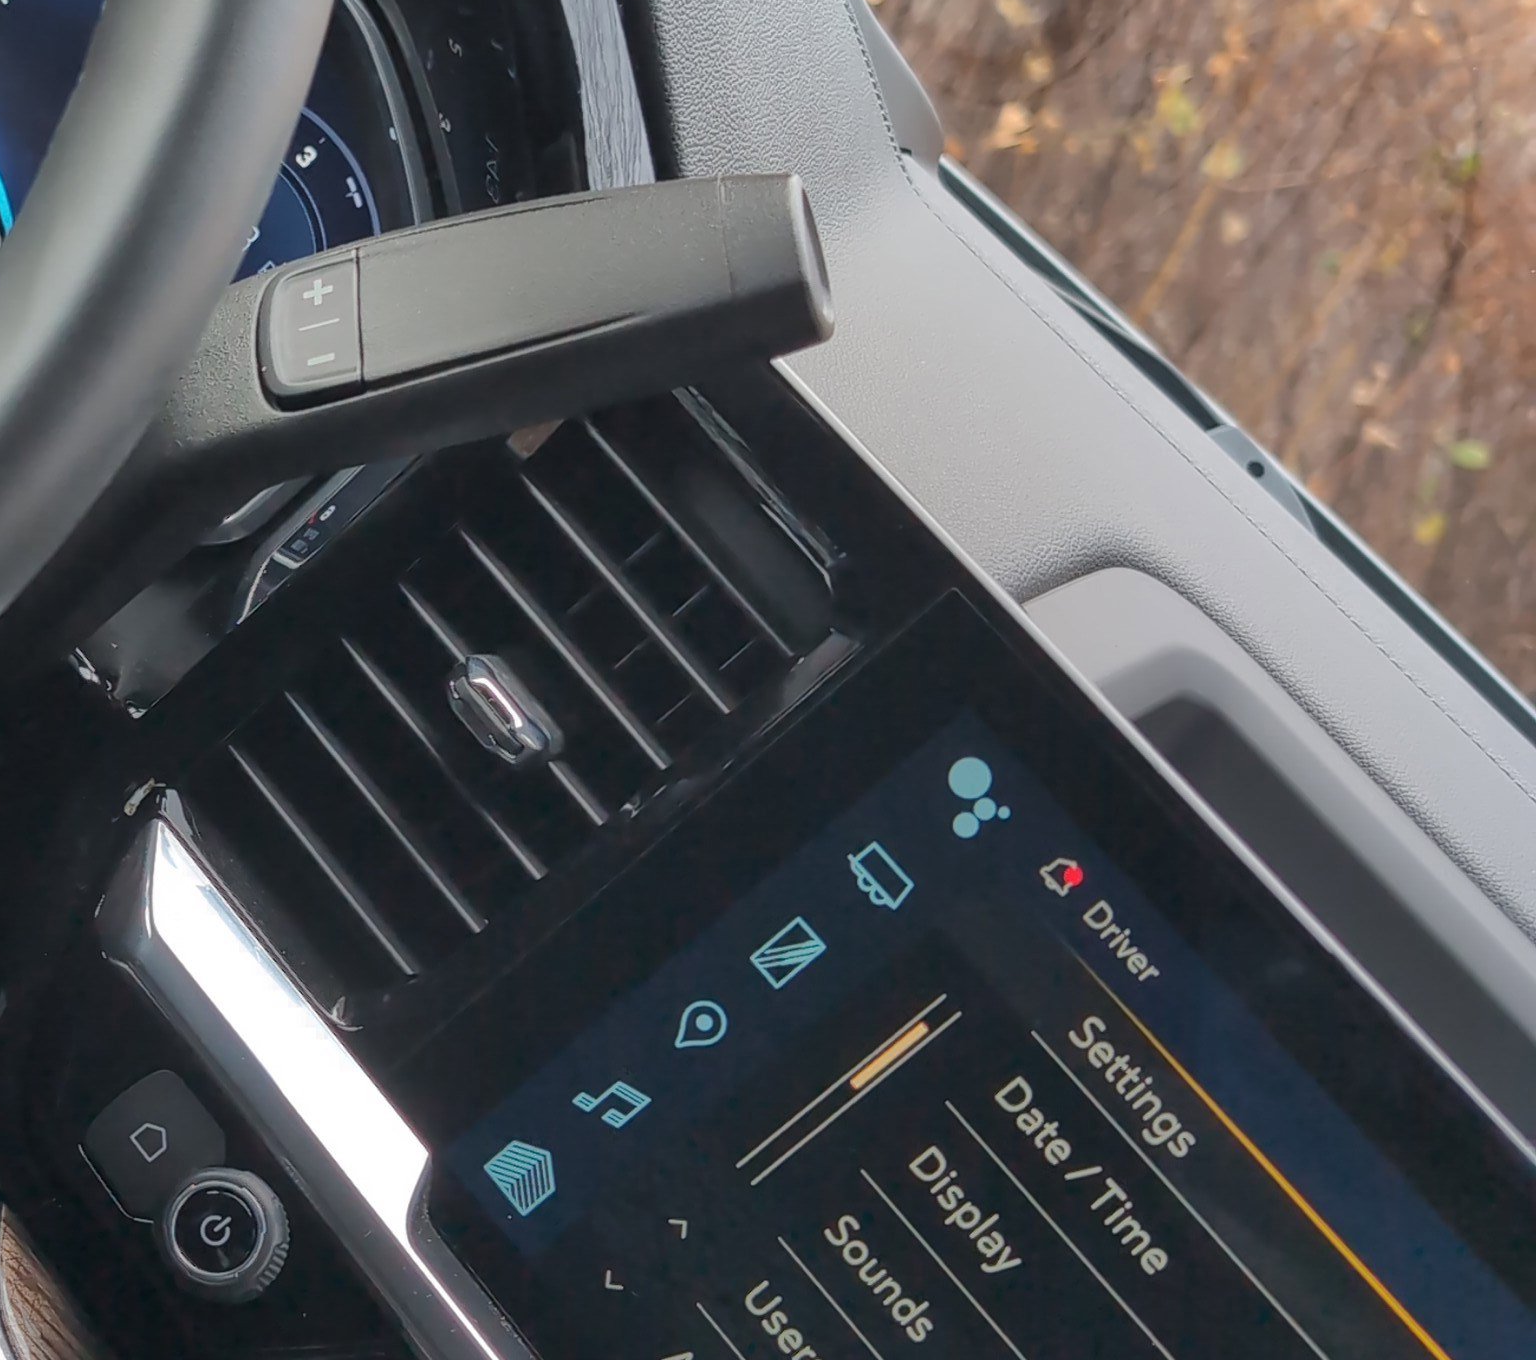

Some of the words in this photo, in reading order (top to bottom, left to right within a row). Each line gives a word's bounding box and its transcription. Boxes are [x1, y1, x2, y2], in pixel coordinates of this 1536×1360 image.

[294, 145, 318, 169] 3
[1080, 898, 1161, 986] Driver
[1067, 1014, 1197, 1161] Settings
[908, 1144, 1022, 1277] Display
[994, 1075, 1075, 1166] Date
[1090, 1178, 1170, 1275] Time
[823, 1214, 938, 1344] Sounds
